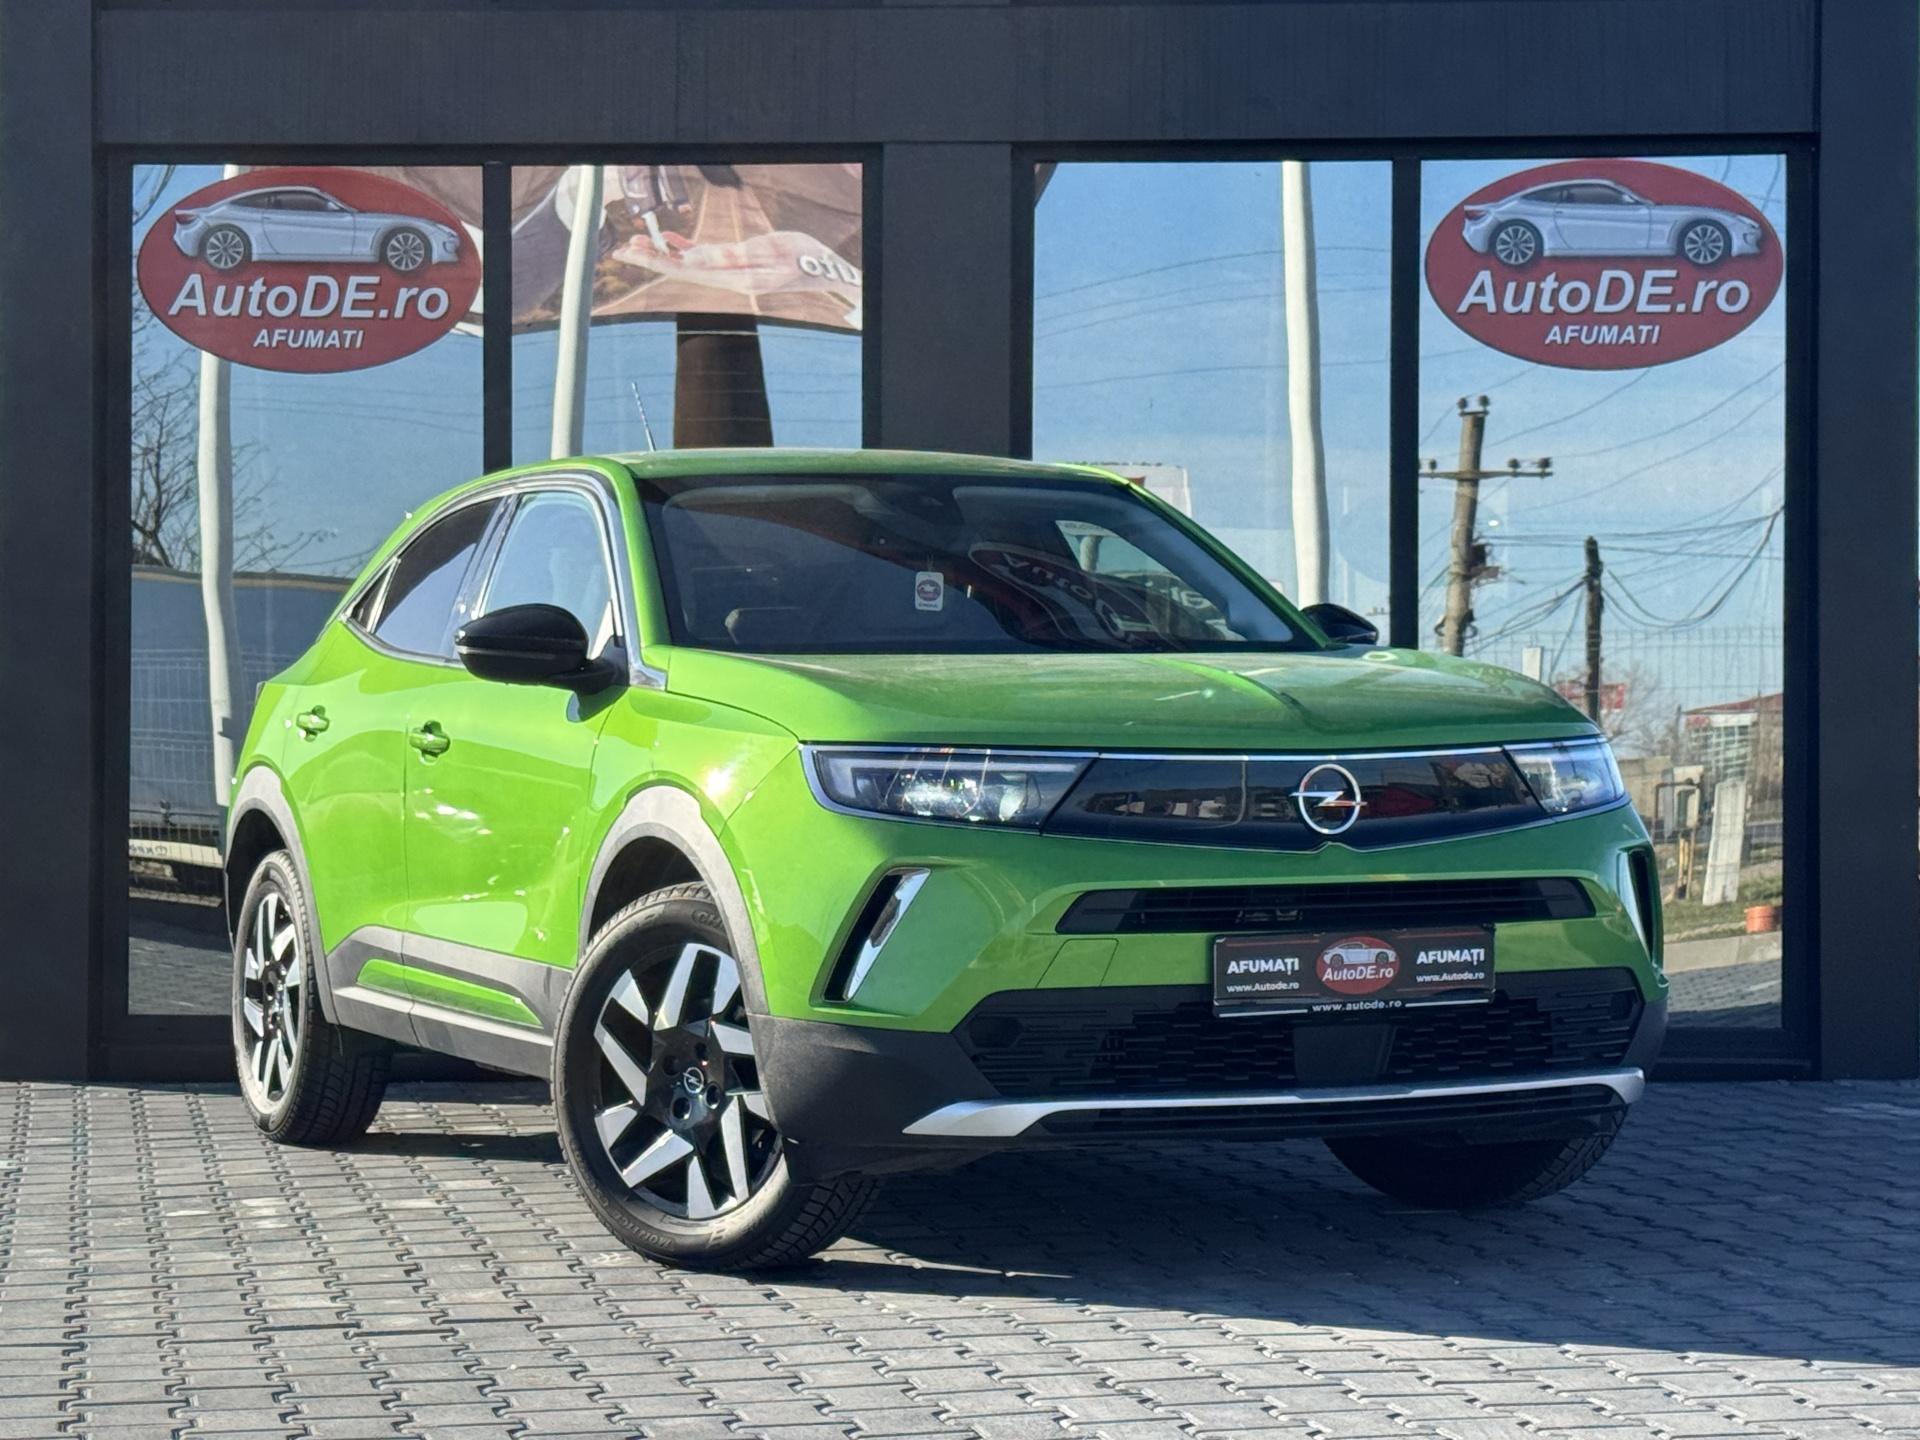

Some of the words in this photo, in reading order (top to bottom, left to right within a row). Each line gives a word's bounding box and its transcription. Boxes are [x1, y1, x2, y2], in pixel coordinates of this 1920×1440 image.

[168, 273, 449, 321] AutoDE.ro
[1456, 269, 1750, 315] AutoDE.ro
[252, 329, 364, 350] AFUMATI
[1545, 325, 1660, 345] AFUMATI
[1322, 966, 1395, 982] AutoDE.ro
[1226, 981, 1300, 993] www.Autode.ro
[1311, 1000, 1402, 1013] www.autode.ro
